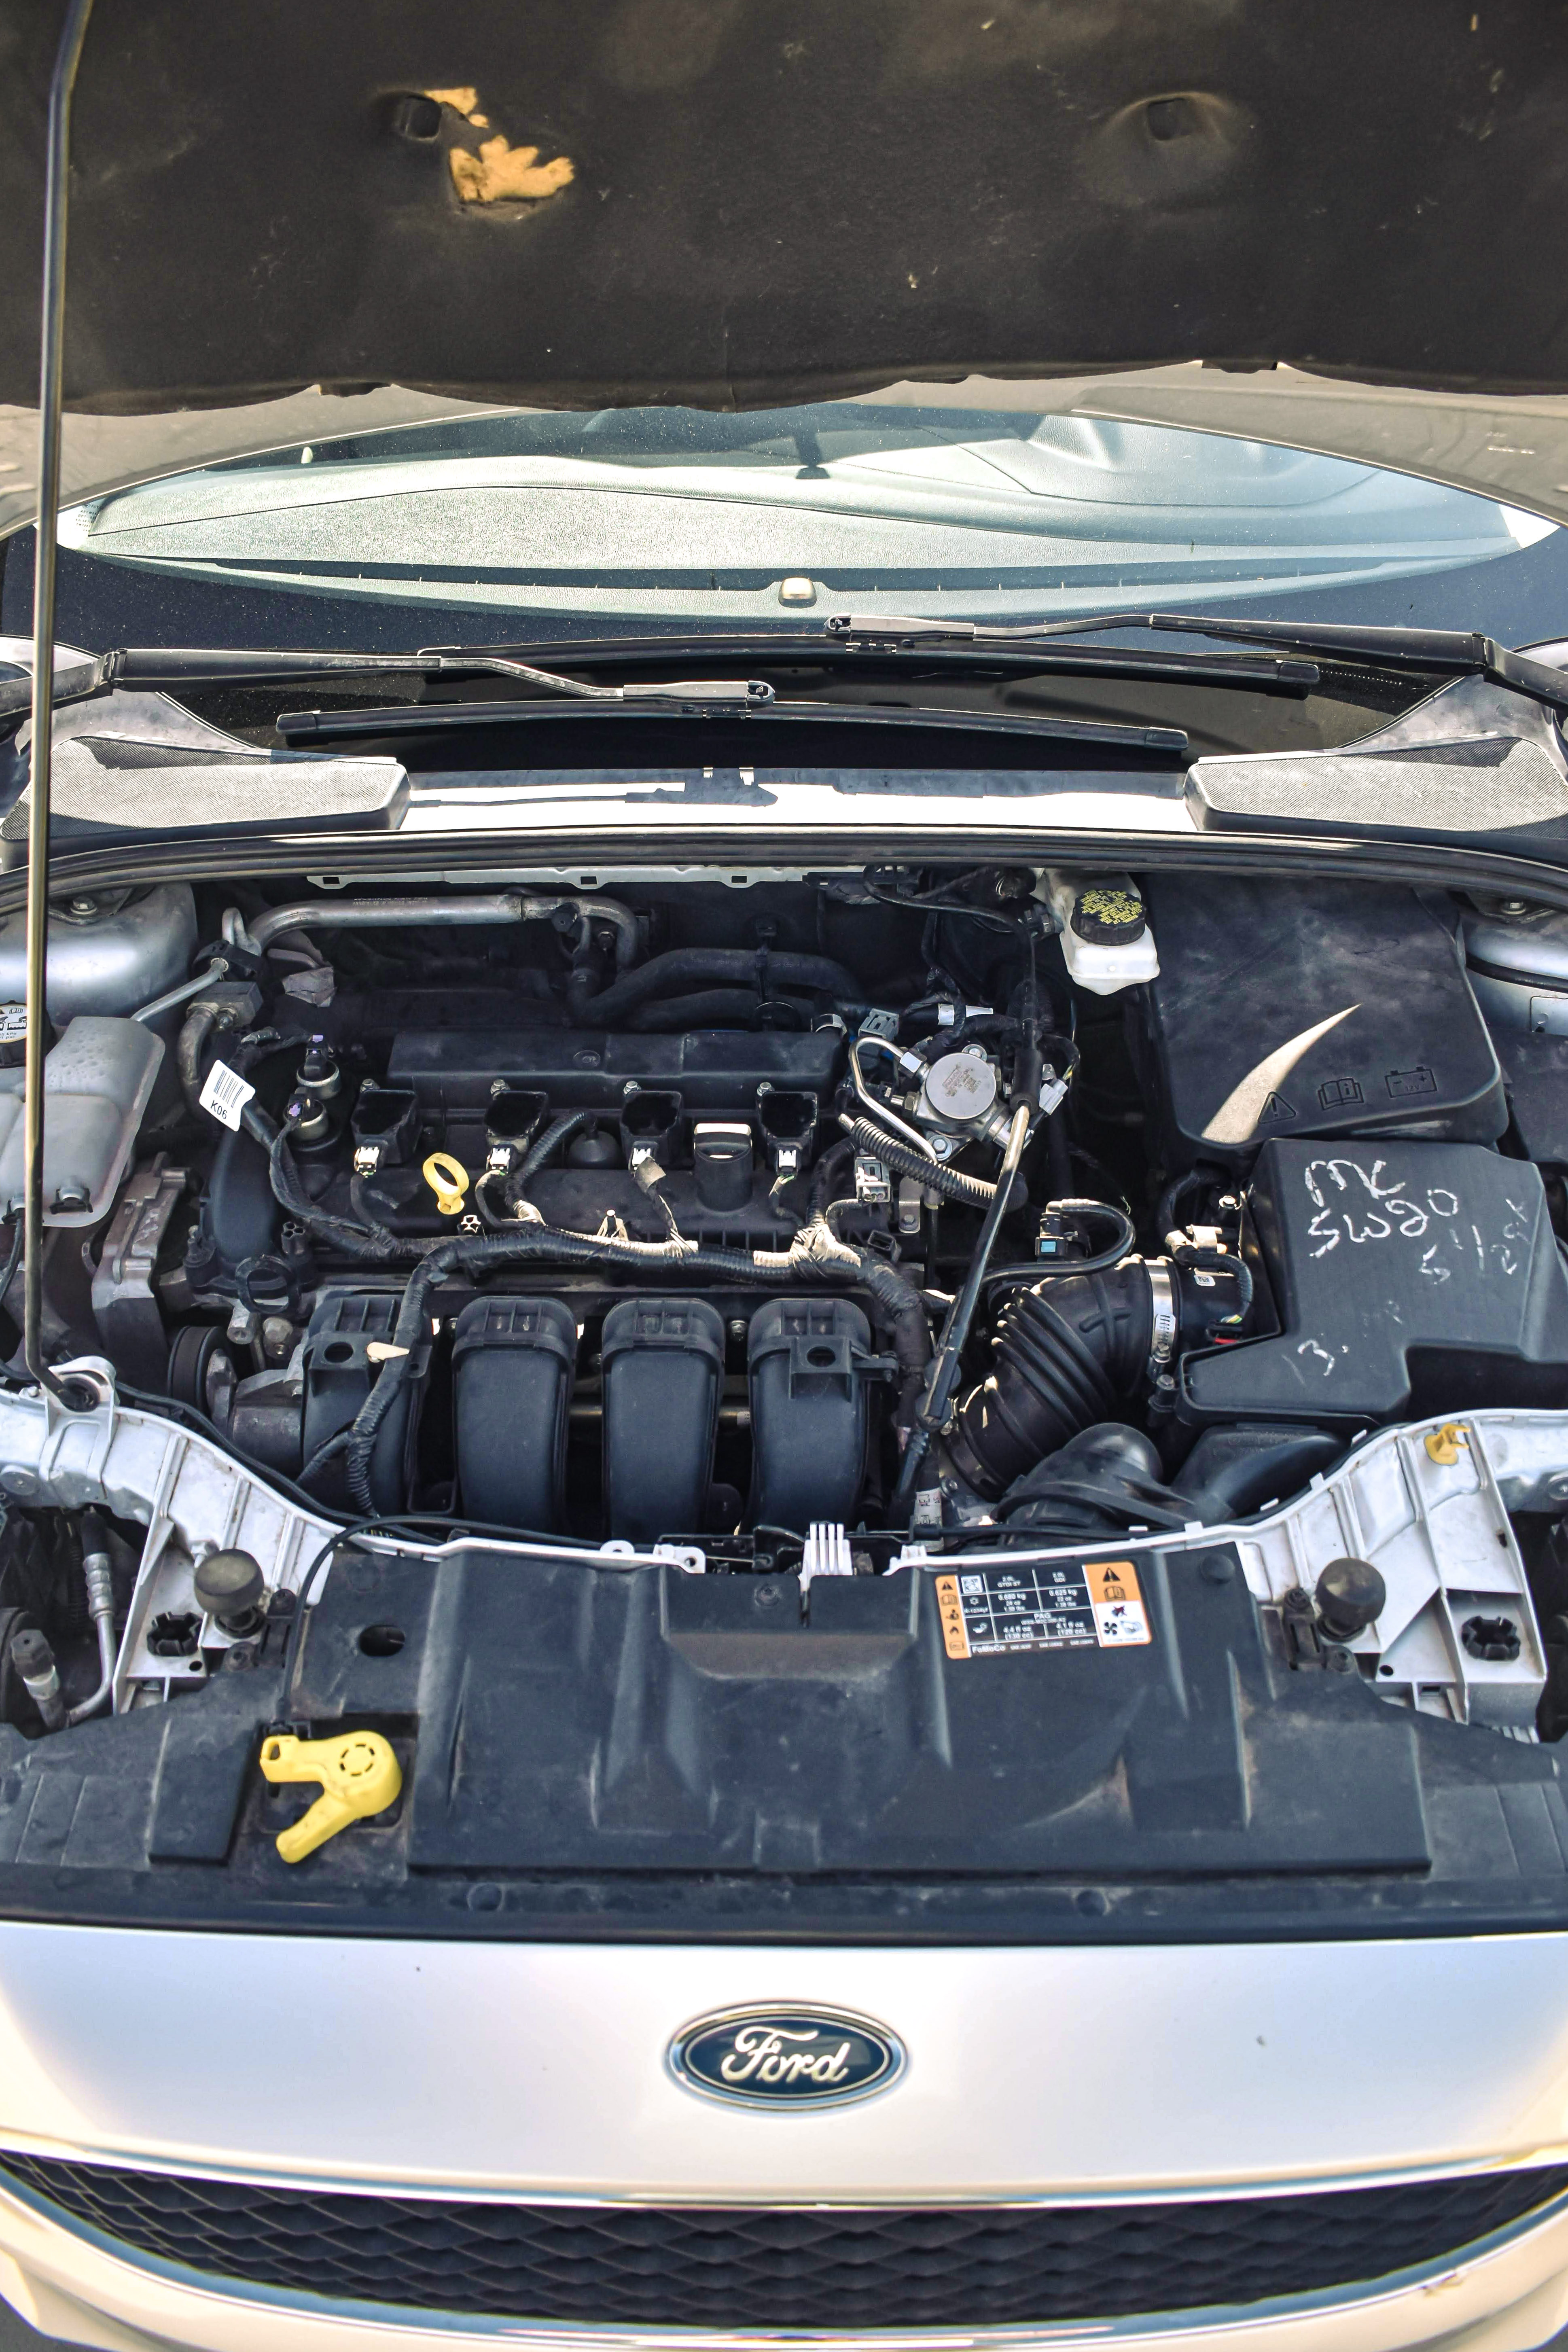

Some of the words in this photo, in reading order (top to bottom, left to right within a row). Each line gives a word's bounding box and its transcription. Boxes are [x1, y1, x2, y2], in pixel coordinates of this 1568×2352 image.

[210, 1100, 227, 1119] K06
[972, 1644, 1006, 1653] FoMoCo
[720, 2026, 850, 2083] Ford
